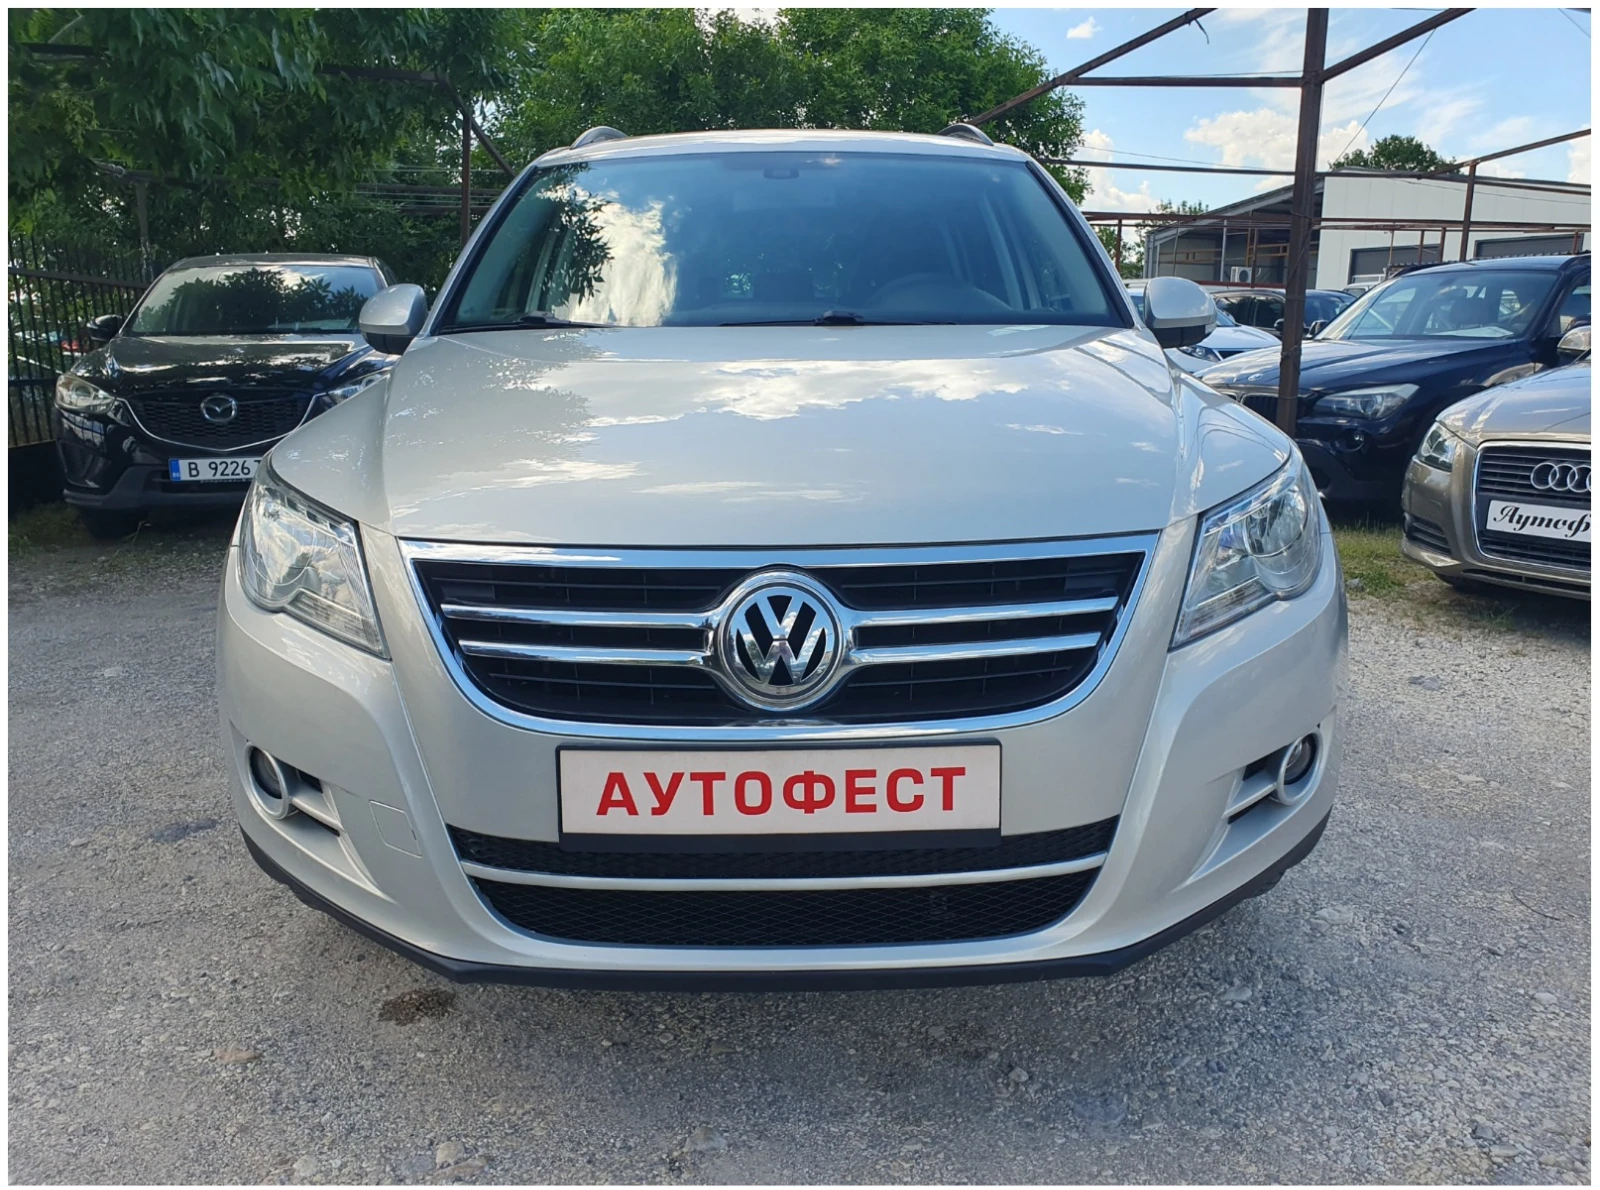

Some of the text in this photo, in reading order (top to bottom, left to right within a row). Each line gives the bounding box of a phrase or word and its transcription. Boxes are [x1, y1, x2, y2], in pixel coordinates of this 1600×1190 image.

[188, 462, 200, 478] B
[208, 460, 251, 477] 9226
[728, 587, 835, 695] VW
[596, 767, 966, 816] АУТОФЕСТ
